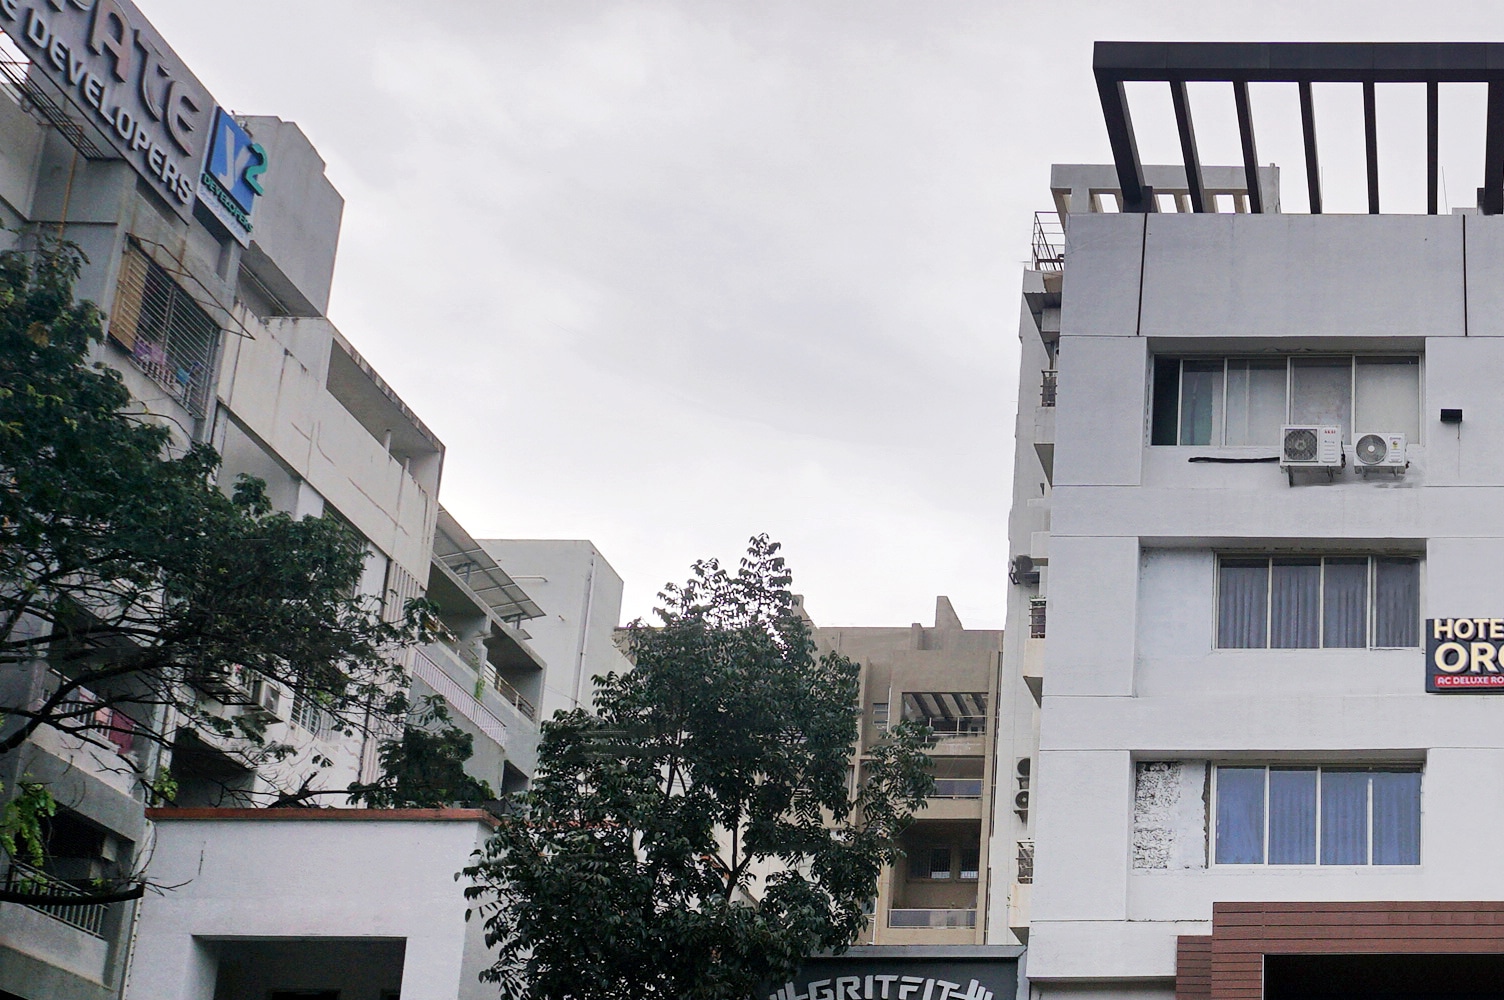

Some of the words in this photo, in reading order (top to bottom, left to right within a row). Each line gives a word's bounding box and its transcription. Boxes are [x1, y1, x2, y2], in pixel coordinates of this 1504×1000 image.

[25, 8, 193, 206] DEVELOPERS
[47, 0, 200, 158] ATE
[202, 173, 254, 233] DEVELOPERS
[1437, 676, 1452, 685] AC
[1453, 676, 1490, 685] DELUXE
